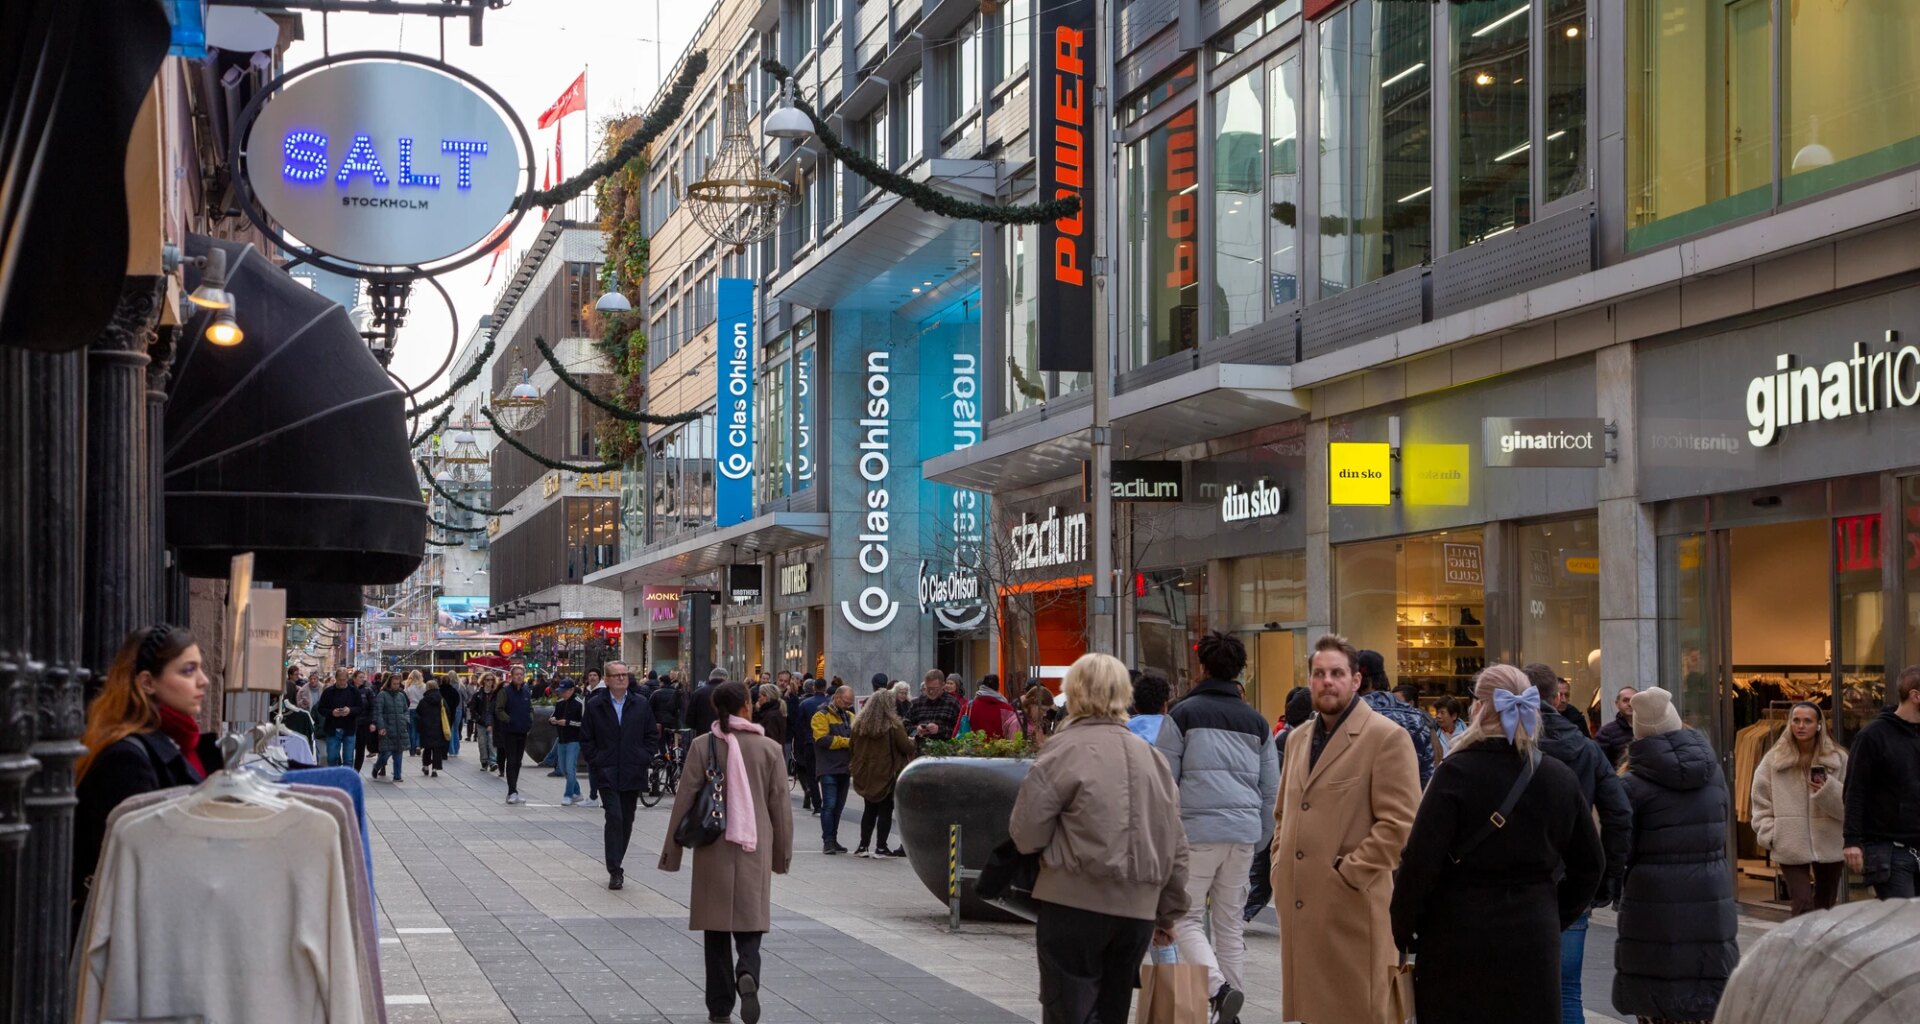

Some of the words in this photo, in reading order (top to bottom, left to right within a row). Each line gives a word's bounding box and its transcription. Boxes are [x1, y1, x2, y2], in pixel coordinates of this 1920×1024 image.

[284, 132, 488, 189] SALT
[1056, 25, 1083, 286] POWER
[342, 197, 429, 209] STOCKHOLM
[730, 322, 747, 396] Ohlson
[729, 399, 747, 448] Clas
[859, 351, 889, 482] Ohlson
[1500, 430, 1593, 453] ginatricot
[1339, 468, 1359, 479] din
[1361, 468, 1382, 479] sko
[1222, 484, 1249, 522] din
[1250, 479, 1281, 519] sko
[859, 488, 889, 574] Clas
[1011, 506, 1087, 570] stadium
[929, 574, 948, 603] Clas
[948, 571, 978, 601] Ohlson
